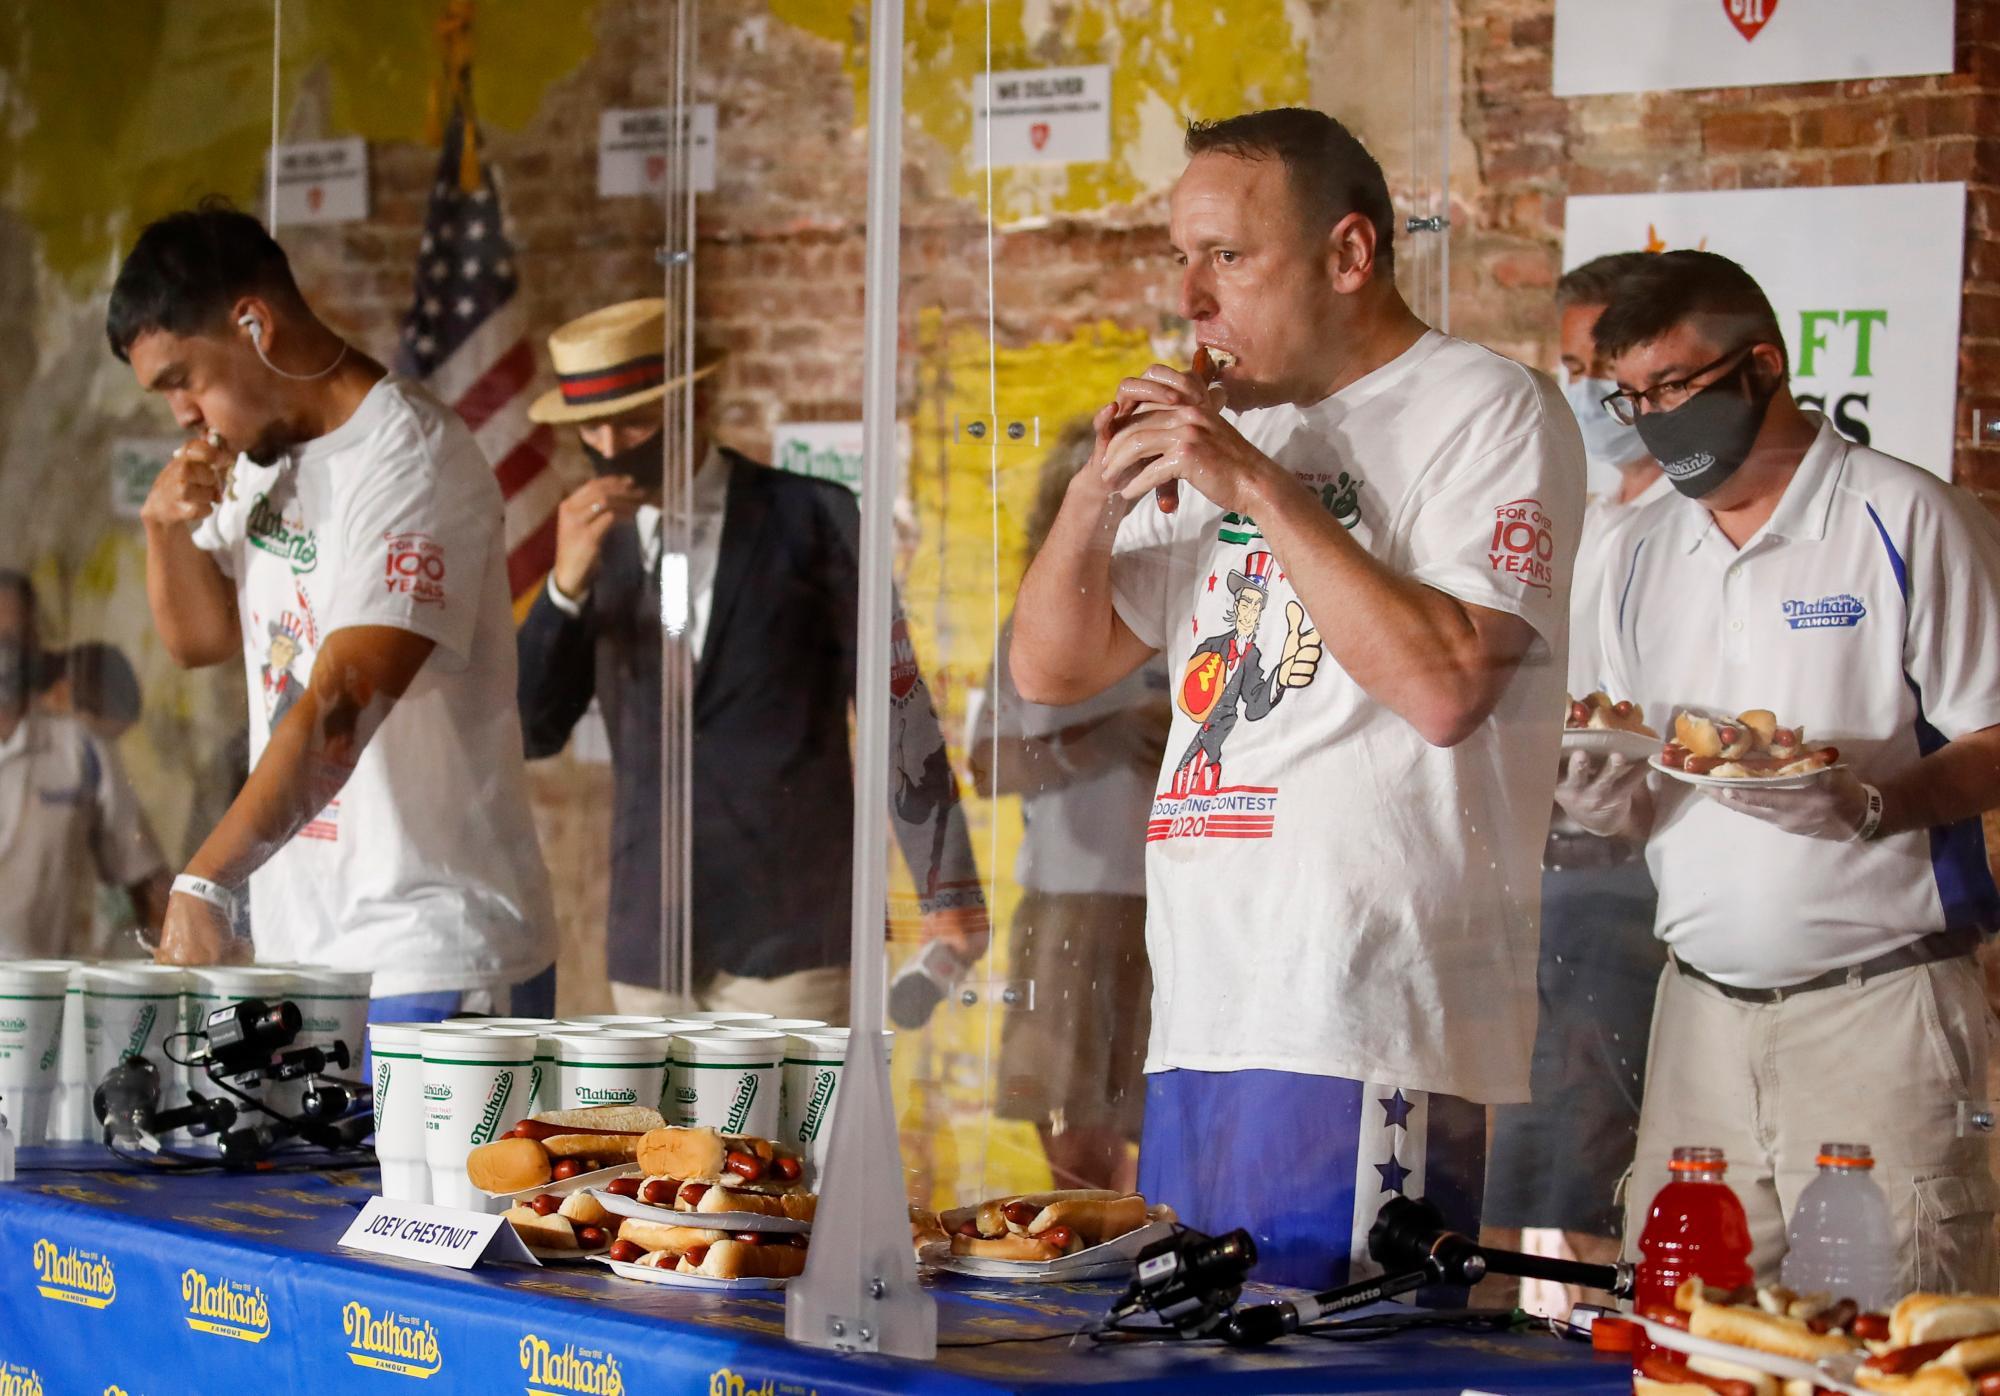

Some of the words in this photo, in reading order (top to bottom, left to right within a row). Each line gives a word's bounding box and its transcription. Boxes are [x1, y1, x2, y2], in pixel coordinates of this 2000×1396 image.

[1795, 310, 1887, 376] FT
[1497, 508, 1527, 520] FOR
[1491, 521, 1553, 562] 100
[386, 552, 445, 581] 100
[1488, 554, 1552, 583] YEARS
[385, 579, 445, 597] YEARS
[1782, 598, 1863, 616] Nathan's
[1797, 616, 1849, 627] FAMOUS
[1211, 796, 1277, 811] CONTEST
[1168, 816, 1206, 838] 2020
[470, 1069, 510, 1145] Nathan's
[575, 1086, 636, 1101] Nathan's
[799, 1069, 832, 1142] Nathan's
[364, 1214, 406, 1238] JOEY
[400, 1220, 478, 1250] CHESTNUT
[33, 1238, 115, 1295] Nathan's
[182, 1268, 269, 1328] Nathan's
[342, 1301, 439, 1363] Nathan's
[0, 1361, 43, 1396] han's
[519, 1334, 622, 1396] Nathan's
